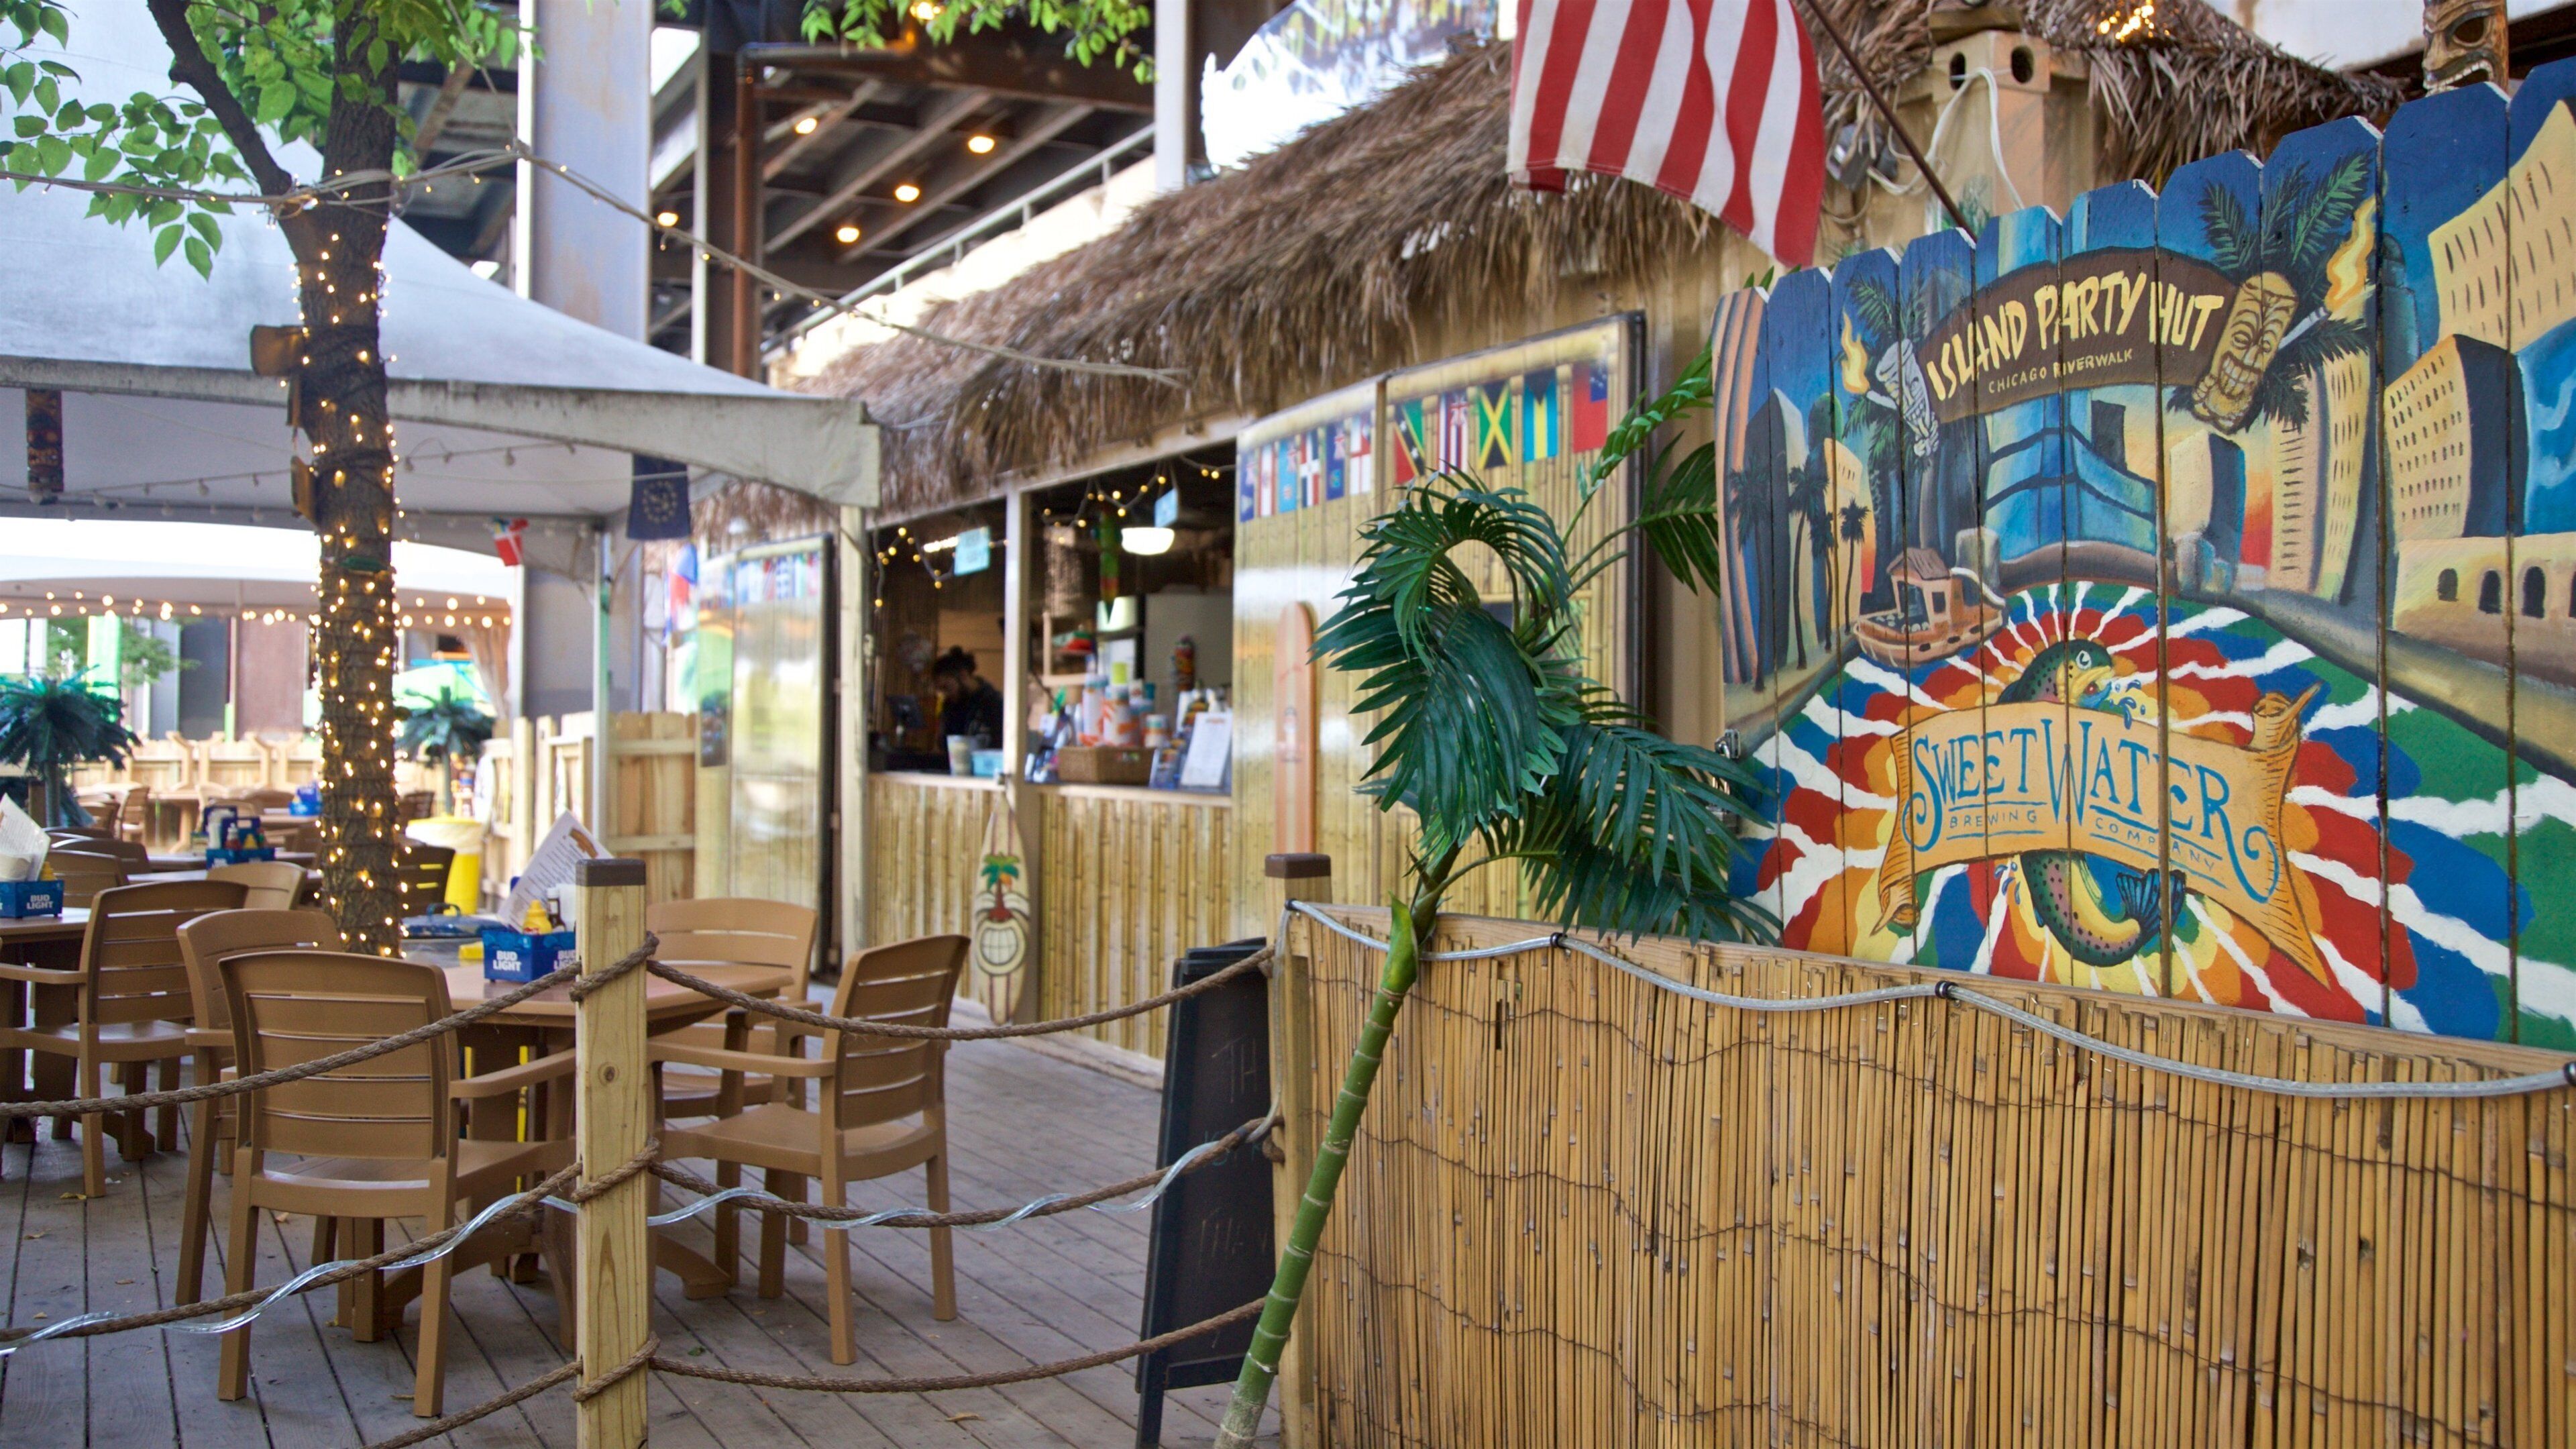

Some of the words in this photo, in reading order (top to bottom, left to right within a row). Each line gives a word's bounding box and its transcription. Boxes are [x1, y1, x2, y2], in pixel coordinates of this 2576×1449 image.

[1926, 300, 2028, 401] ISLAND
[2033, 270, 2147, 350] PARTY
[2149, 280, 2224, 352] HUT
[1988, 366, 2047, 394] CHICAGO
[2053, 348, 2133, 379] RIVERWALK
[1950, 809, 2039, 829] BREWING
[2095, 816, 2214, 872] COMPANY
[30, 894, 50, 902] BUD
[26, 901, 53, 910] LIGHT
[496, 950, 518, 961] BUD
[492, 959, 522, 972] LIGHT
